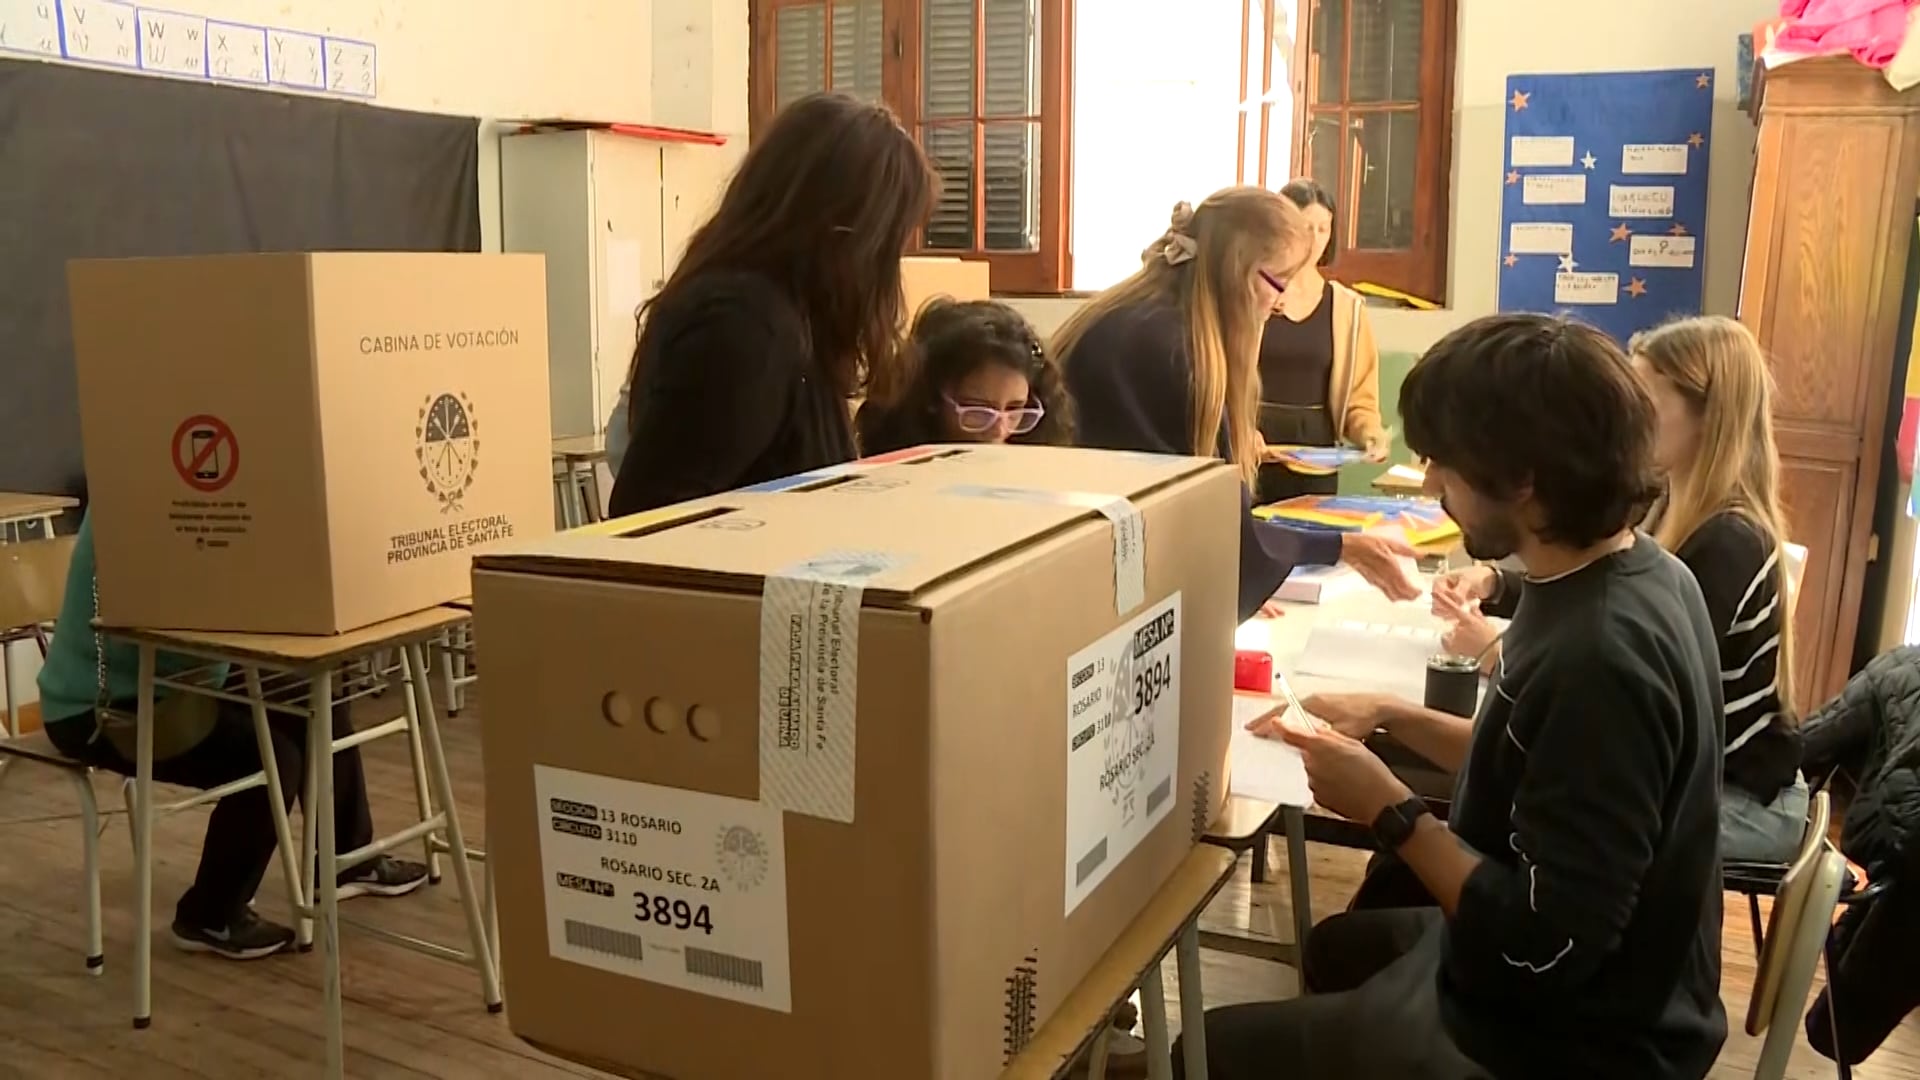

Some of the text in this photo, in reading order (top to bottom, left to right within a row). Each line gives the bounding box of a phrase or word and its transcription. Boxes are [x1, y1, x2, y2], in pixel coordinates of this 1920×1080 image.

[73, 6, 86, 25] V
[147, 20, 199, 41] W w
[217, 34, 229, 52] X
[274, 36, 284, 55] Y
[359, 327, 519, 355] CABINA DE VOTACIÓN
[387, 524, 514, 564] PROVINCIA DE SANTA FE
[391, 514, 508, 549] TRIBUNAL ELECTORAL
[817, 613, 829, 674] Provincia
[829, 584, 848, 696] Tribunal Electoral
[1133, 617, 1160, 660] MESA
[817, 676, 827, 693] de
[1134, 653, 1171, 715] 3894
[816, 696, 827, 731] Santa
[1073, 686, 1102, 719] ROSARIO
[816, 734, 826, 751] Fe
[1099, 752, 1132, 792] ROSARIO
[601, 808, 616, 823] 13
[621, 812, 682, 835] ROSARIO
[606, 828, 638, 847] 3110
[558, 873, 593, 893] MESA
[600, 856, 721, 894] ROSARIO SEC. 2A
[633, 891, 714, 935] 3894
